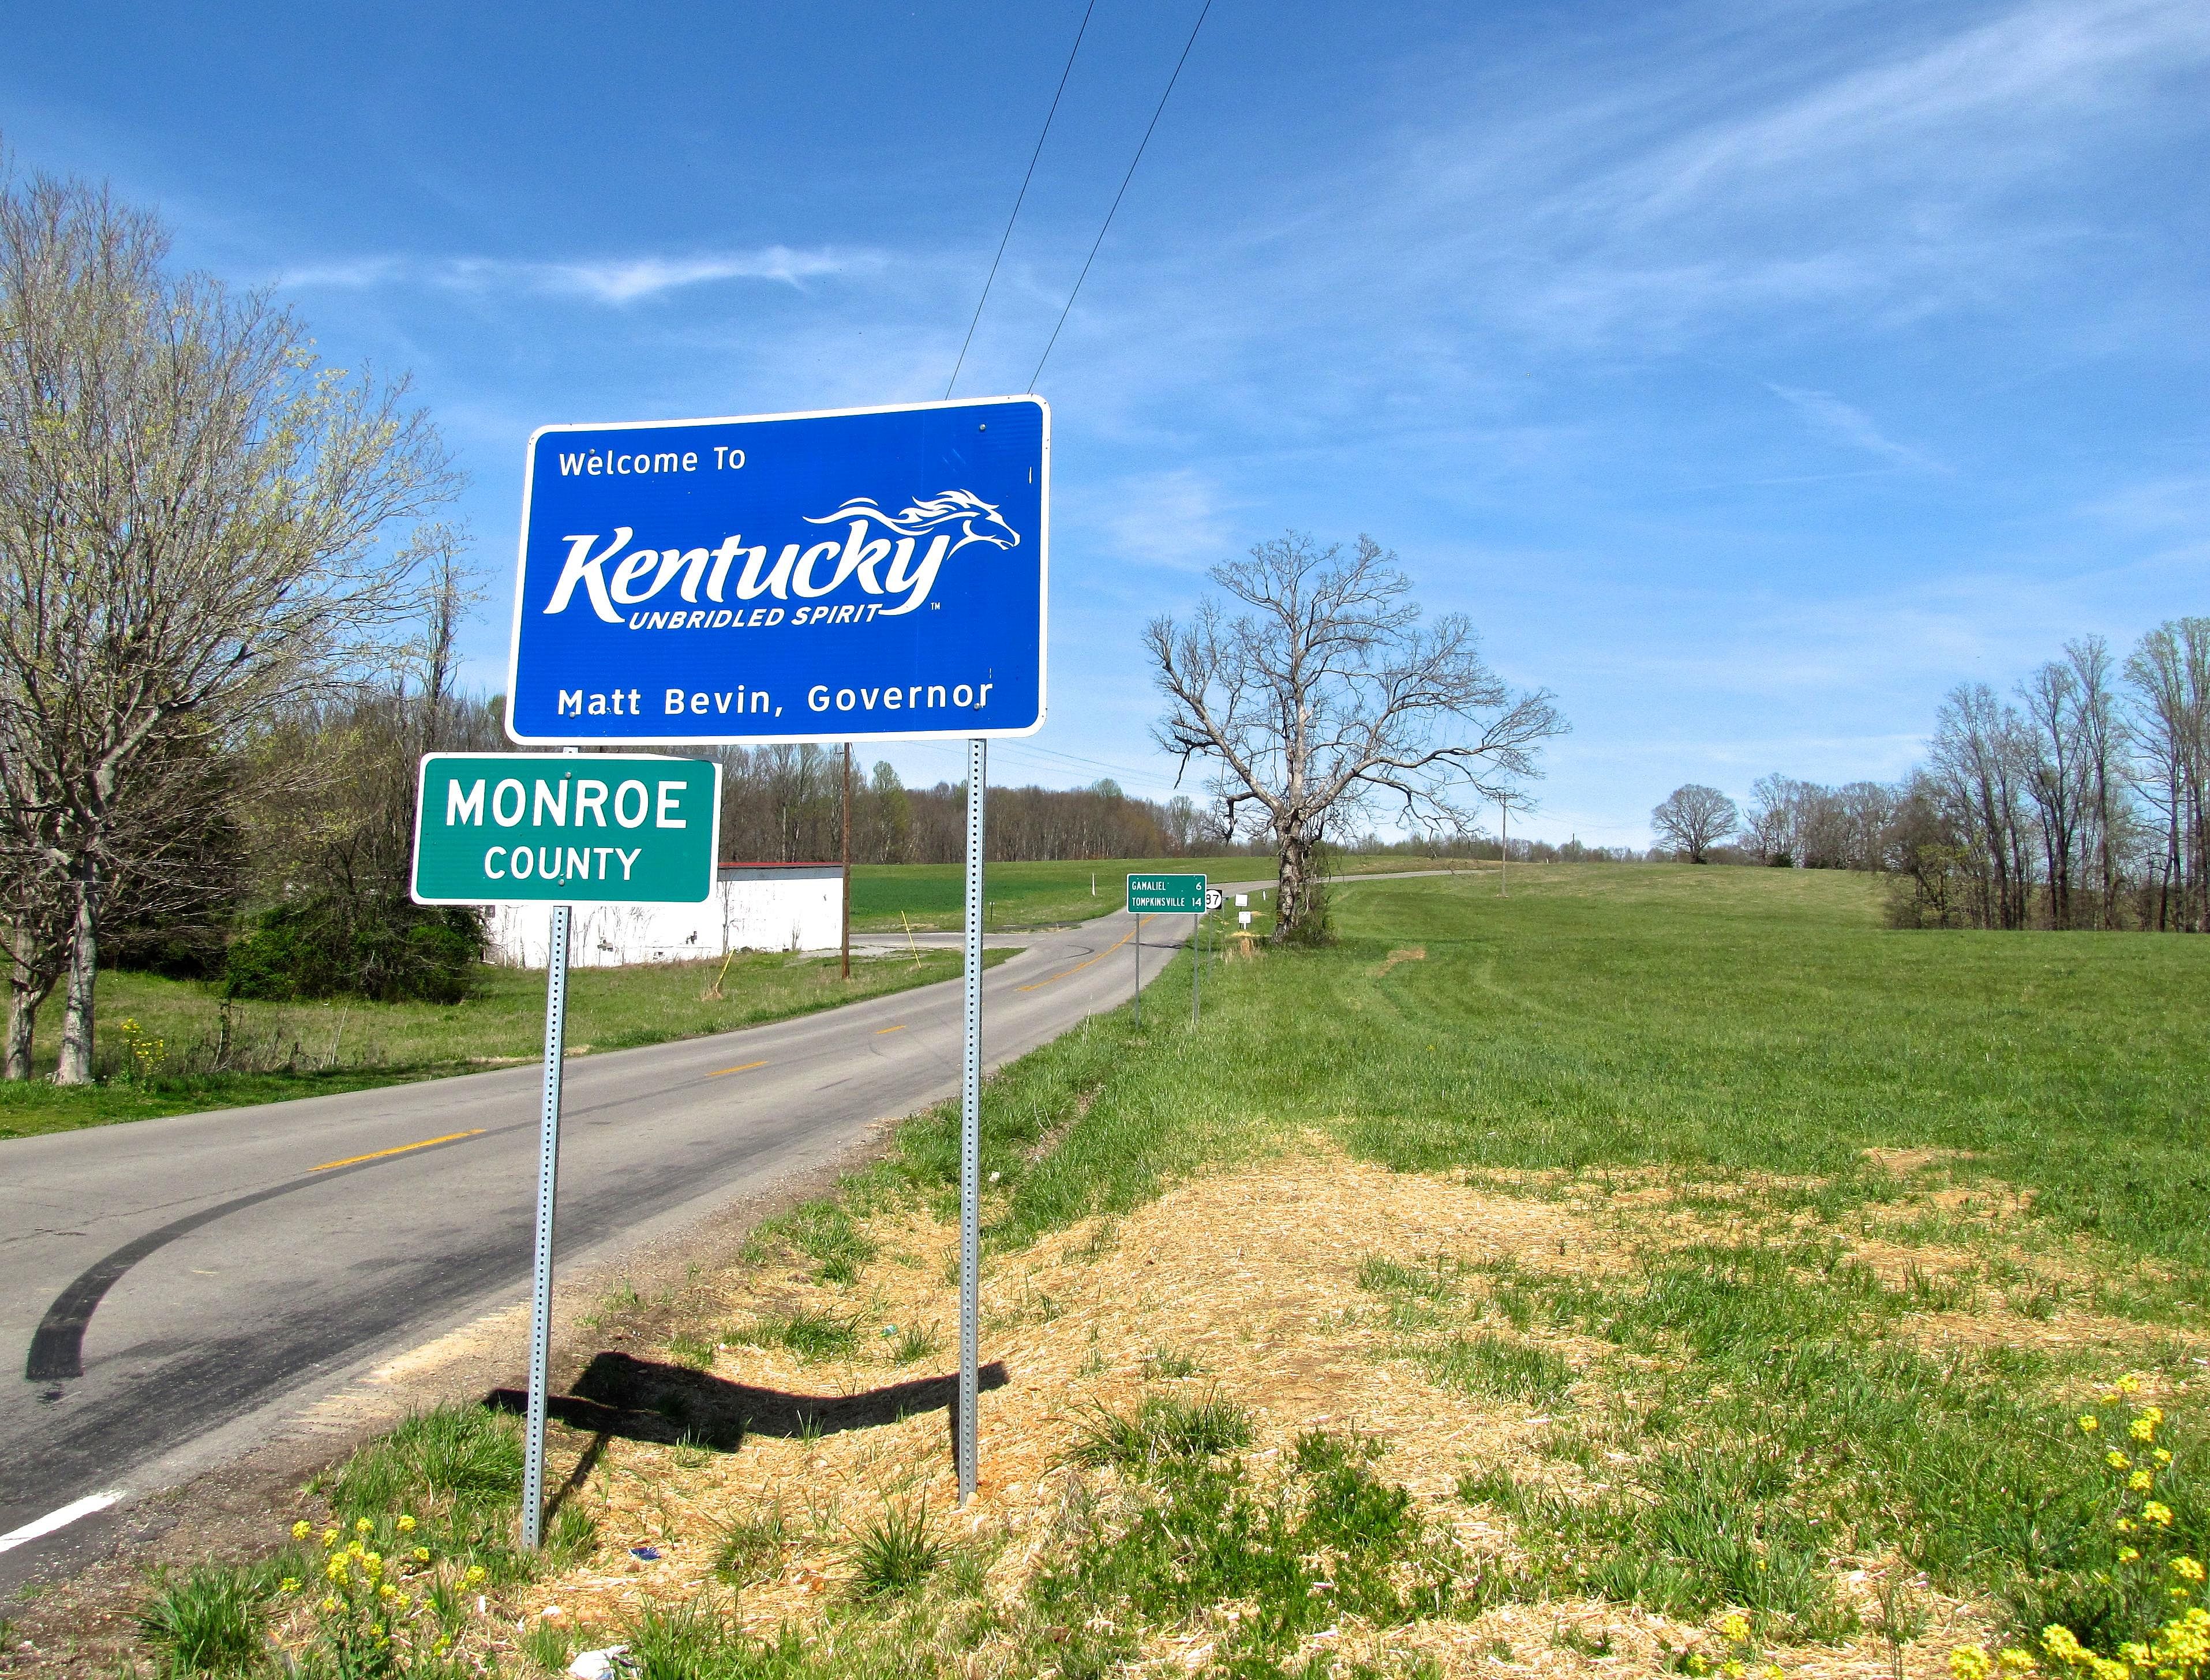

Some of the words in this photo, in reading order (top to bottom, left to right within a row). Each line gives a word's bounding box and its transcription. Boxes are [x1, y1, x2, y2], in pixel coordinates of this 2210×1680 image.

[559, 450, 698, 476] Welcome
[713, 447, 746, 470] To
[543, 519, 950, 623] Kentucky
[628, 608, 785, 630] UNBRIDLED
[791, 604, 881, 625] SPIRIT
[558, 689, 641, 717] Matt
[665, 685, 782, 717] Bevin,
[808, 683, 993, 712] Governor
[446, 778, 687, 828] MONROE
[484, 846, 642, 880] COUNTY
[1132, 881, 1166, 891] GAMALIEL
[1196, 882, 1202, 891] 6
[1132, 897, 1185, 906] TOMPKINSVILLE
[1192, 897, 1201, 906] 14
